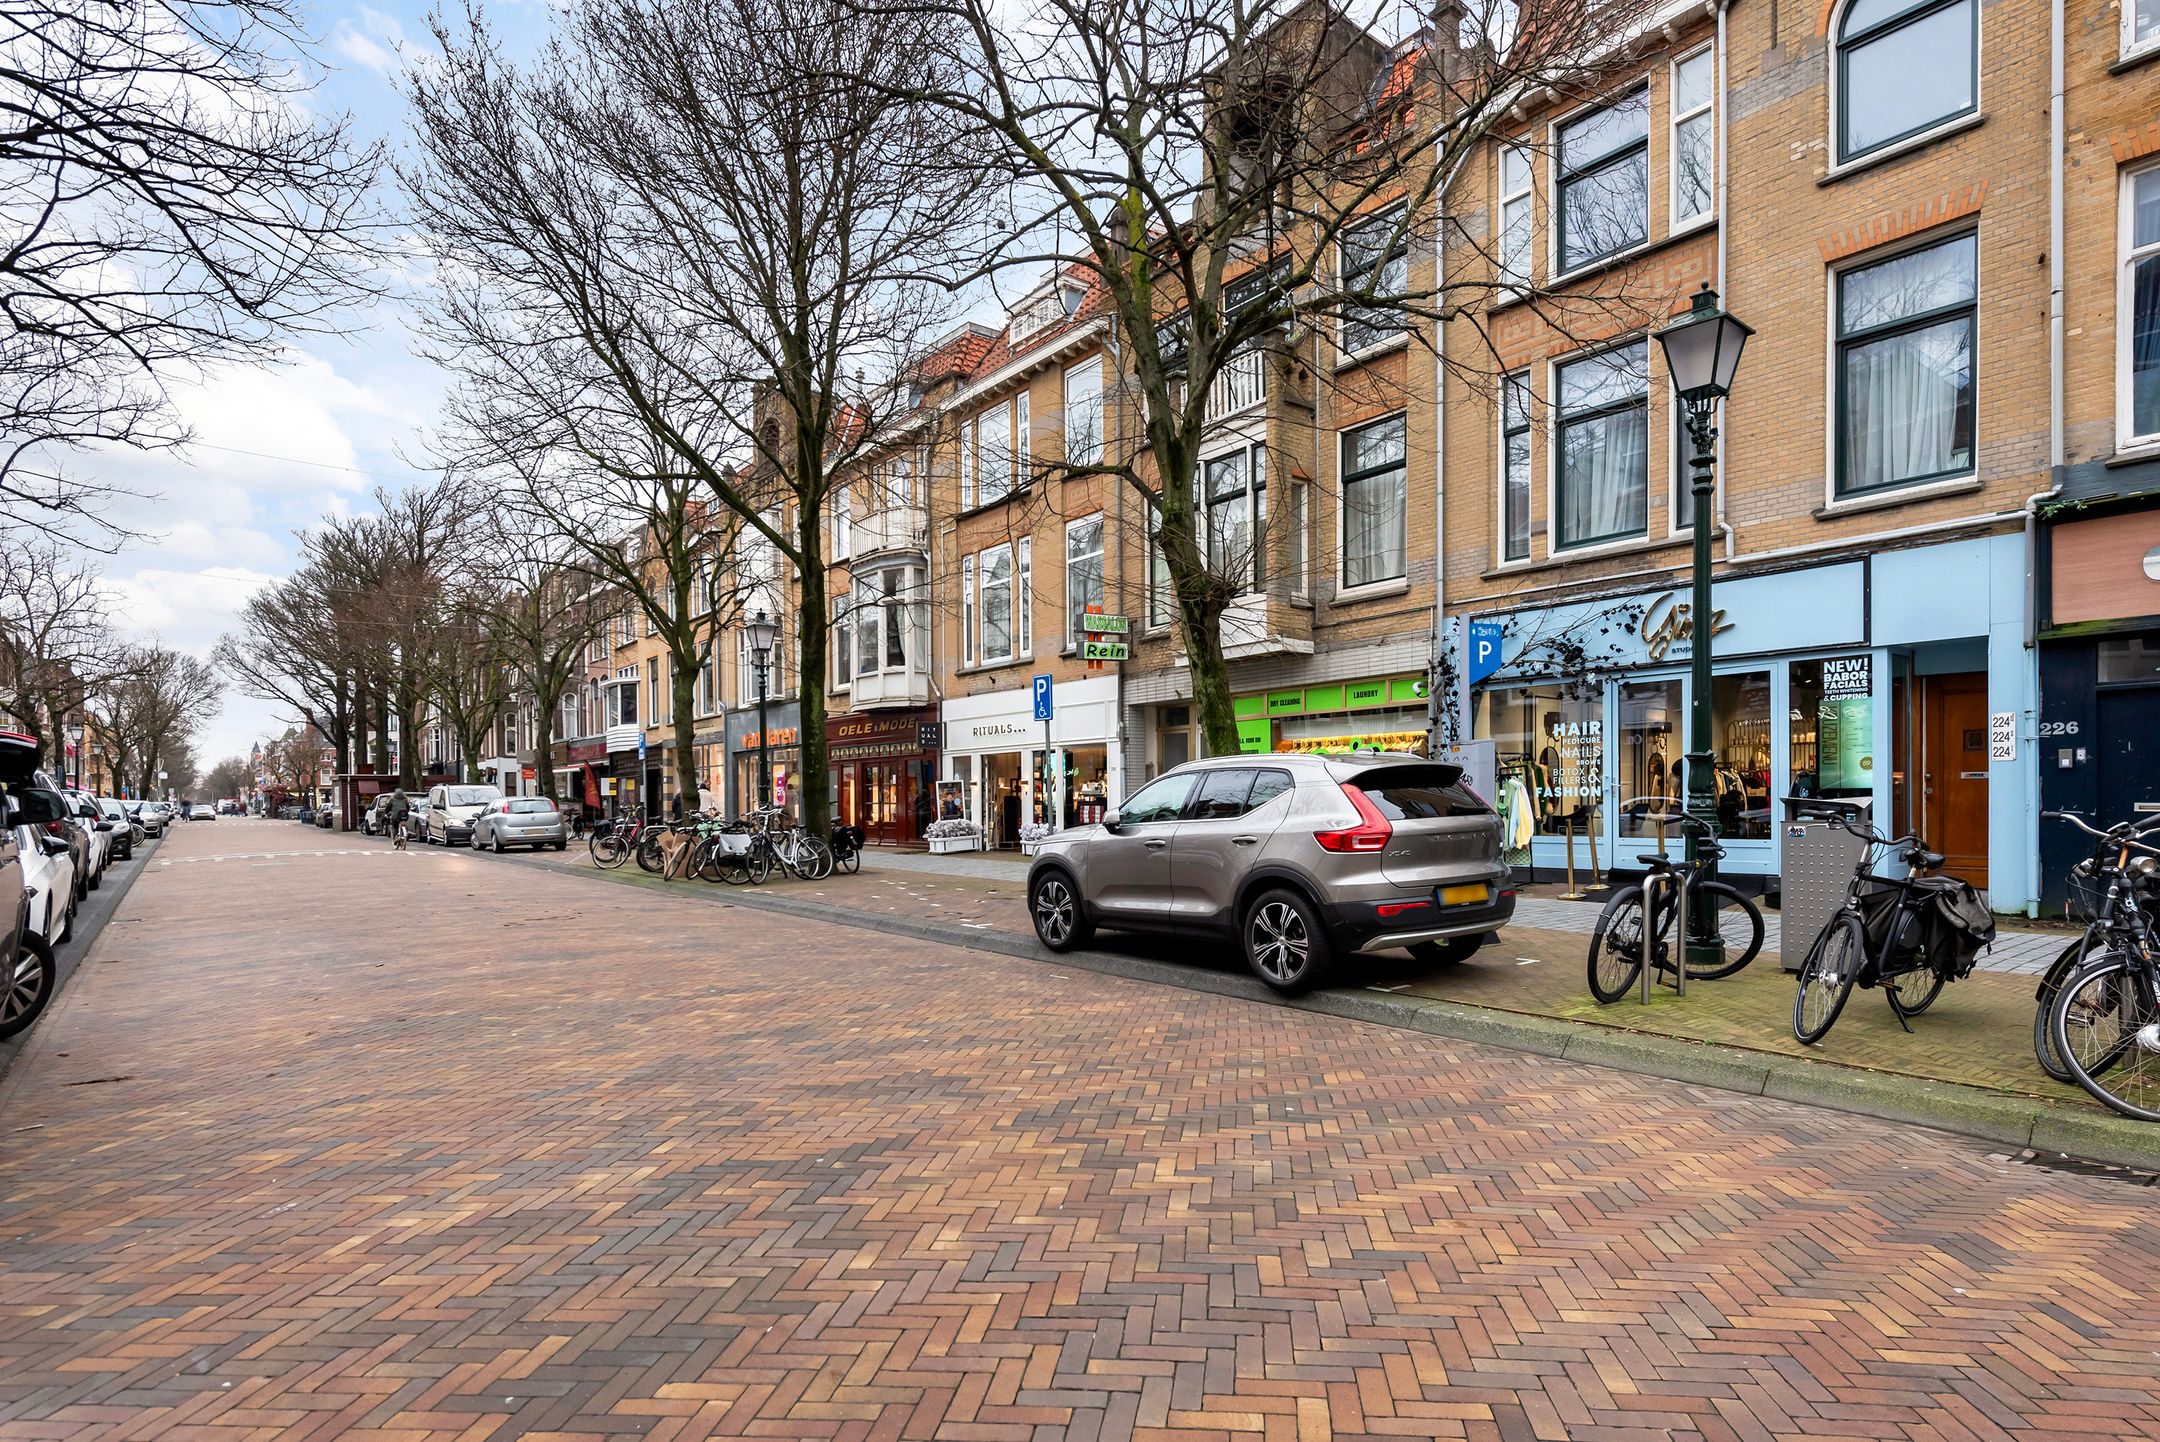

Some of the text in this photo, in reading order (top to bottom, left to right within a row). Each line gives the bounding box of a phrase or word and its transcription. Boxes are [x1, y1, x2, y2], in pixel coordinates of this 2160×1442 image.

[1086, 644, 1125, 657] Rein
[1479, 640, 1492, 664] P
[1823, 658, 1869, 673] NEW!
[1823, 671, 1868, 682] BABOR
[1036, 678, 1047, 702] P
[1823, 680, 1868, 690] FACIALS
[1353, 689, 1378, 699] LAUNDRY
[1829, 693, 1868, 701] CUPPING
[1280, 697, 1301, 706] CLEANING
[839, 722, 873, 736] OELE
[878, 718, 917, 732] MODE
[1992, 716, 2011, 728] 224
[2039, 721, 2079, 735] 226
[973, 723, 1026, 737] RITUALS...
[1553, 721, 1601, 737] HAIR
[1562, 737, 1601, 745] PEDICURE
[1992, 731, 2011, 743] 224
[1561, 746, 1601, 758] NAILS
[1992, 746, 2011, 758] 224
[1553, 767, 1585, 776] BOTOX
[1553, 776, 1587, 785] FILLERS
[1535, 786, 1601, 797] FASHION
